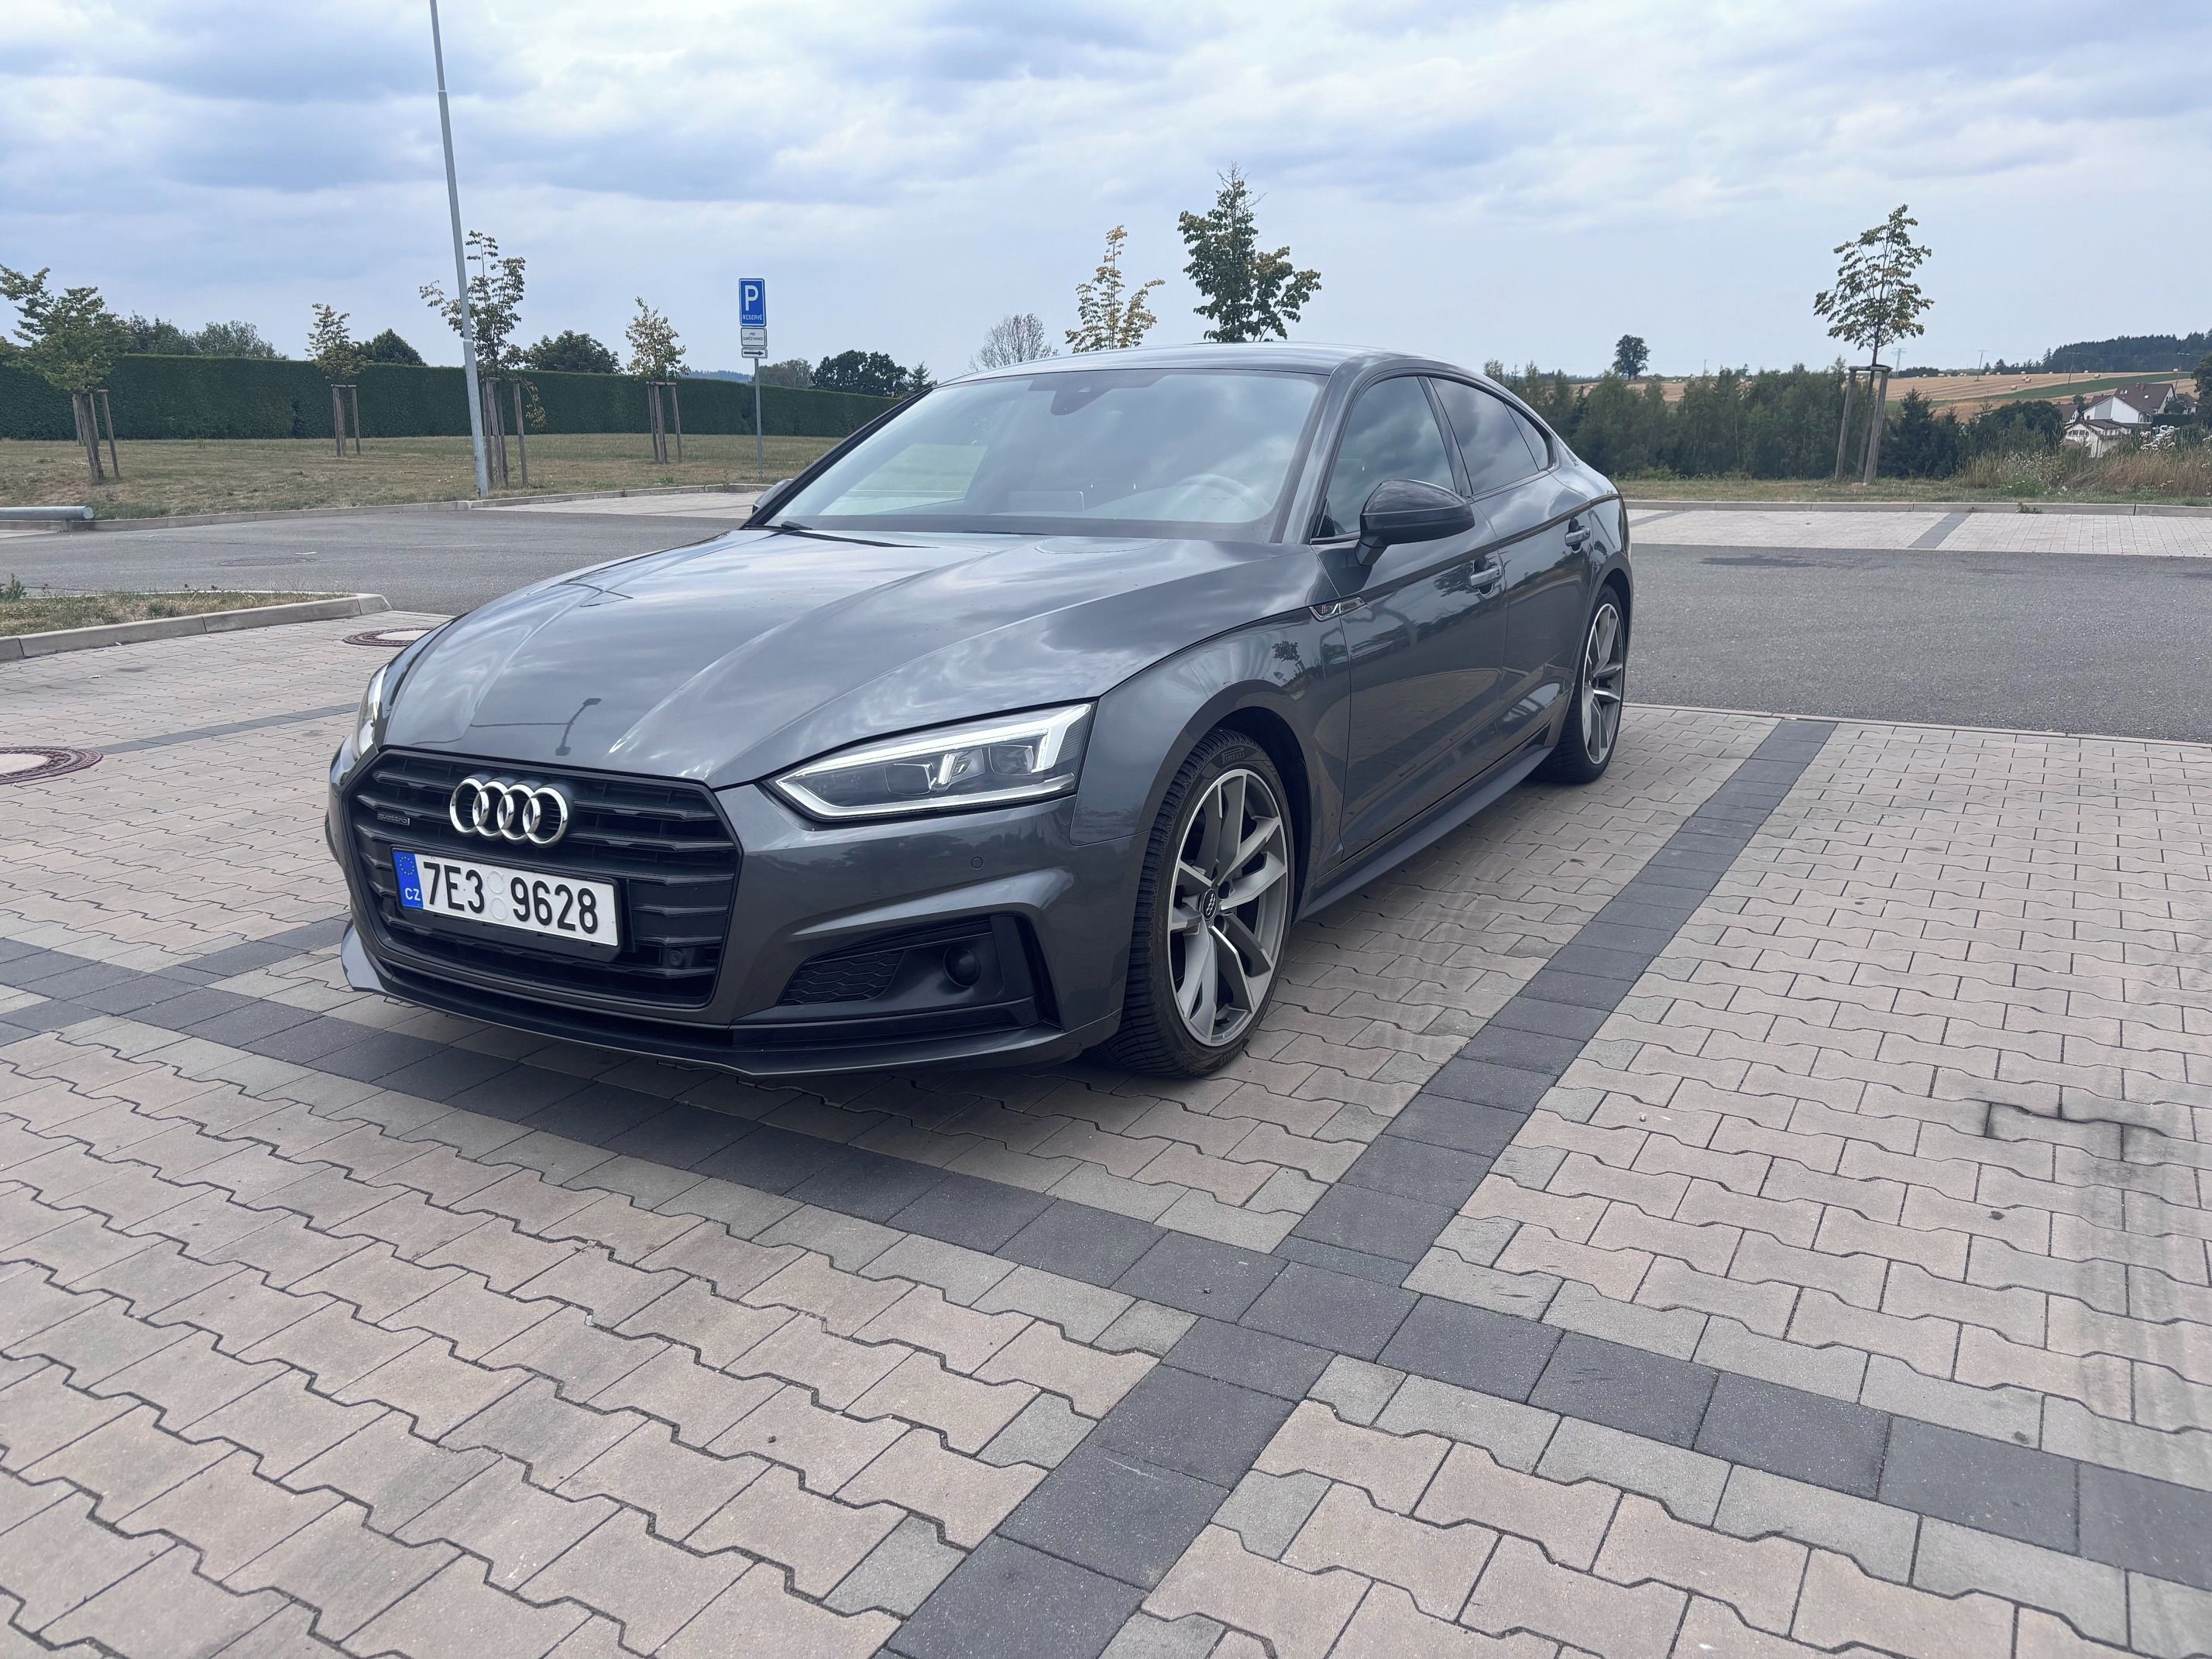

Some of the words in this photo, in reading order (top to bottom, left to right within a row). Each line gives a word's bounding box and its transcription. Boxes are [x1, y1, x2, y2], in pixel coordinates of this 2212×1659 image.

[744, 285, 759, 311] P
[377, 812, 408, 824] quattro
[405, 888, 421, 901] CZ
[423, 860, 485, 914] 7E3
[510, 877, 599, 934] 9628
